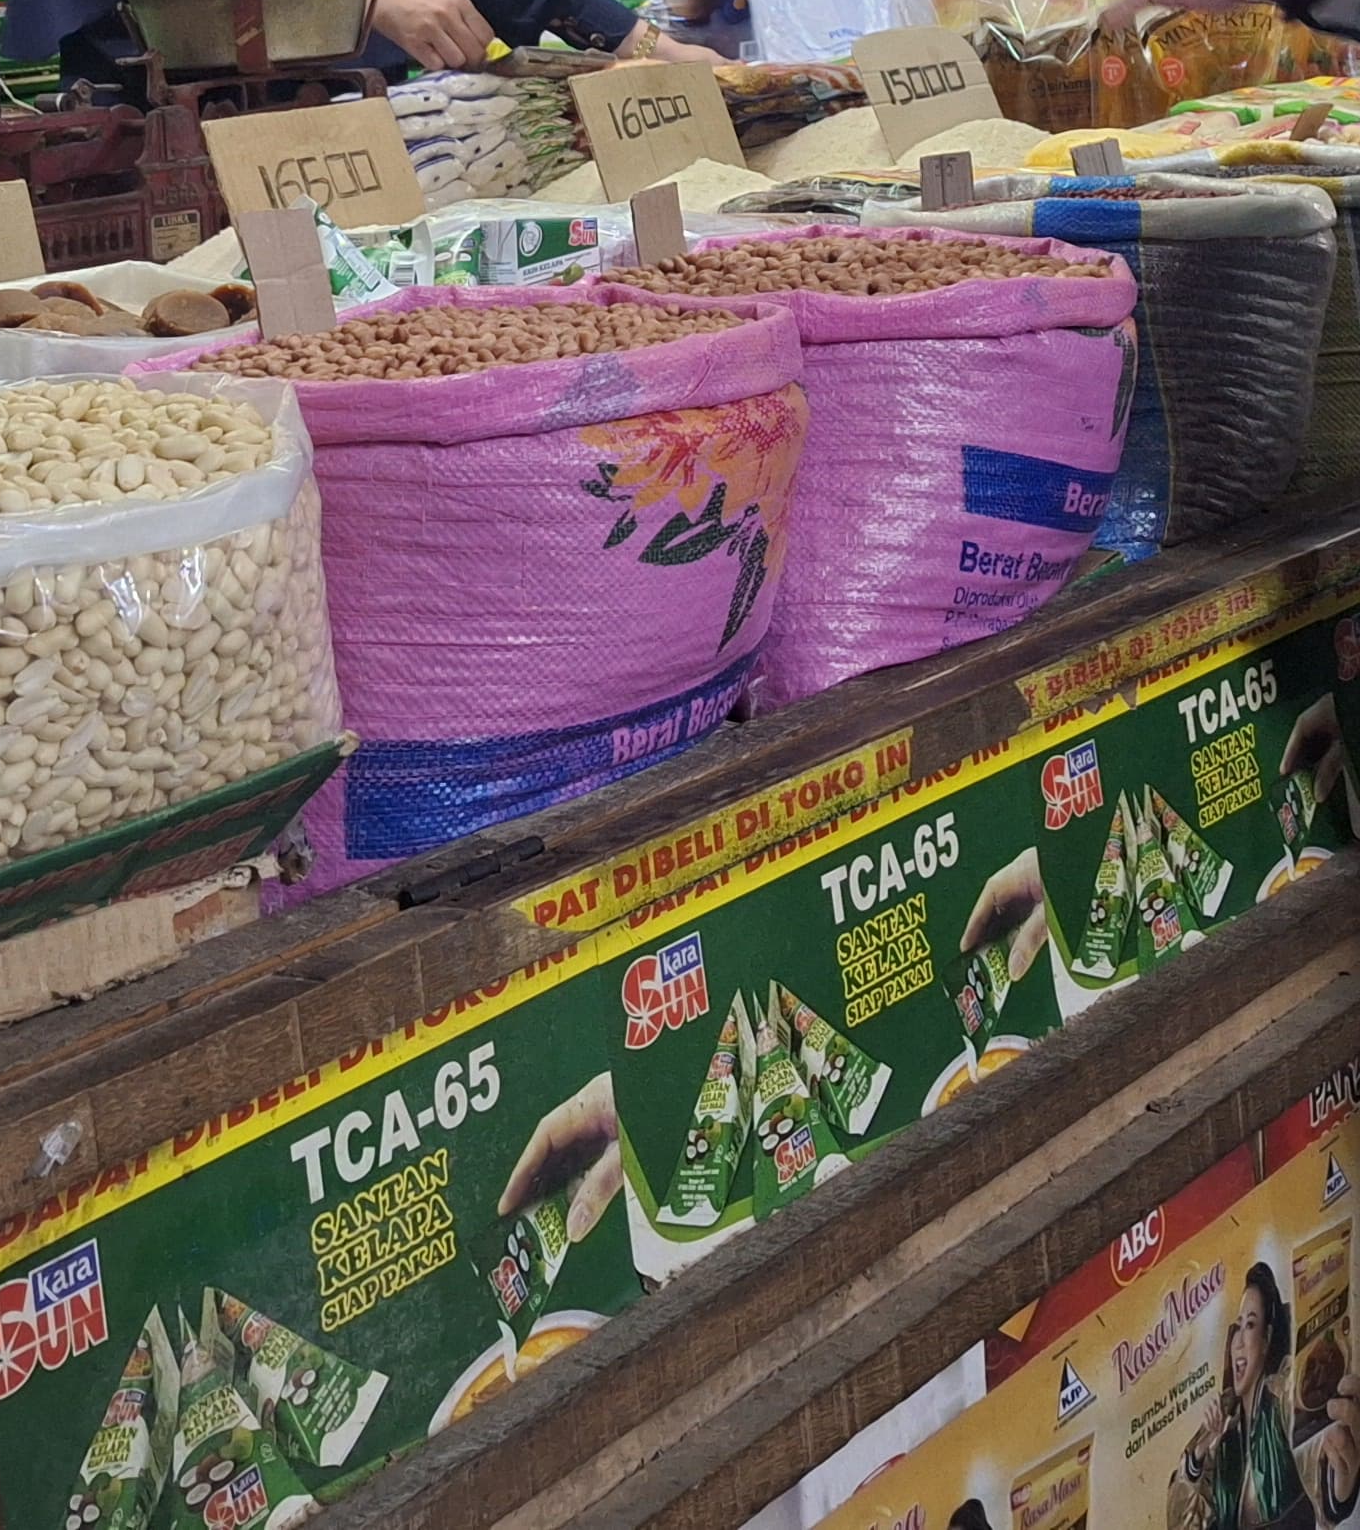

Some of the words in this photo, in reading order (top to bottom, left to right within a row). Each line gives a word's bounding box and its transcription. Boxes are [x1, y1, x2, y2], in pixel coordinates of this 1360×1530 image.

[606, 93, 692, 139] 16000
[880, 60, 966, 106] 15000
[256, 147, 384, 211] 16500
[568, 218, 597, 247] SUN
[959, 539, 1025, 581] Berat
[1045, 647, 1122, 700] DIBELI
[1177, 658, 1278, 745] TCA-65
[610, 708, 684, 765] Berat
[1069, 746, 1096, 777] kara
[1190, 723, 1255, 777] SANTAN
[1040, 754, 1105, 831] SUN
[1195, 752, 1260, 806] KELAPA
[1199, 798, 1227, 829] SIAP
[1226, 779, 1262, 815] PAKAI
[534, 877, 600, 935] PAT
[610, 821, 726, 902] DIBELI
[736, 801, 772, 843] DI
[779, 759, 867, 821] TOKO
[873, 738, 909, 778] IN
[820, 811, 960, 926] TCA-65
[660, 942, 700, 978] kara
[836, 892, 926, 966] SANTAN
[843, 928, 931, 1000] KELAPA
[845, 988, 884, 1029] SIAP
[883, 960, 934, 1008] PAKAI
[621, 952, 710, 1051] SUN
[289, 1040, 502, 1205] TCA-65
[310, 1147, 449, 1256] SANTAN
[317, 1197, 454, 1296] KELAPA
[1116, 1210, 1161, 1271] ABC
[36, 1251, 96, 1302] kara
[320, 1278, 380, 1332] SIAP
[380, 1231, 457, 1299] PAKAI
[1109, 1258, 1226, 1399] RasaMasa
[1060, 1384, 1084, 1410] KSP
[1123, 1436, 1147, 1460] dari
[1146, 1413, 1176, 1449] Masa
[1175, 1398, 1189, 1420] ke
[1188, 1374, 1217, 1409] Masa
[1130, 1393, 1169, 1437] Bumbu
[1167, 1360, 1211, 1408] Warisan
